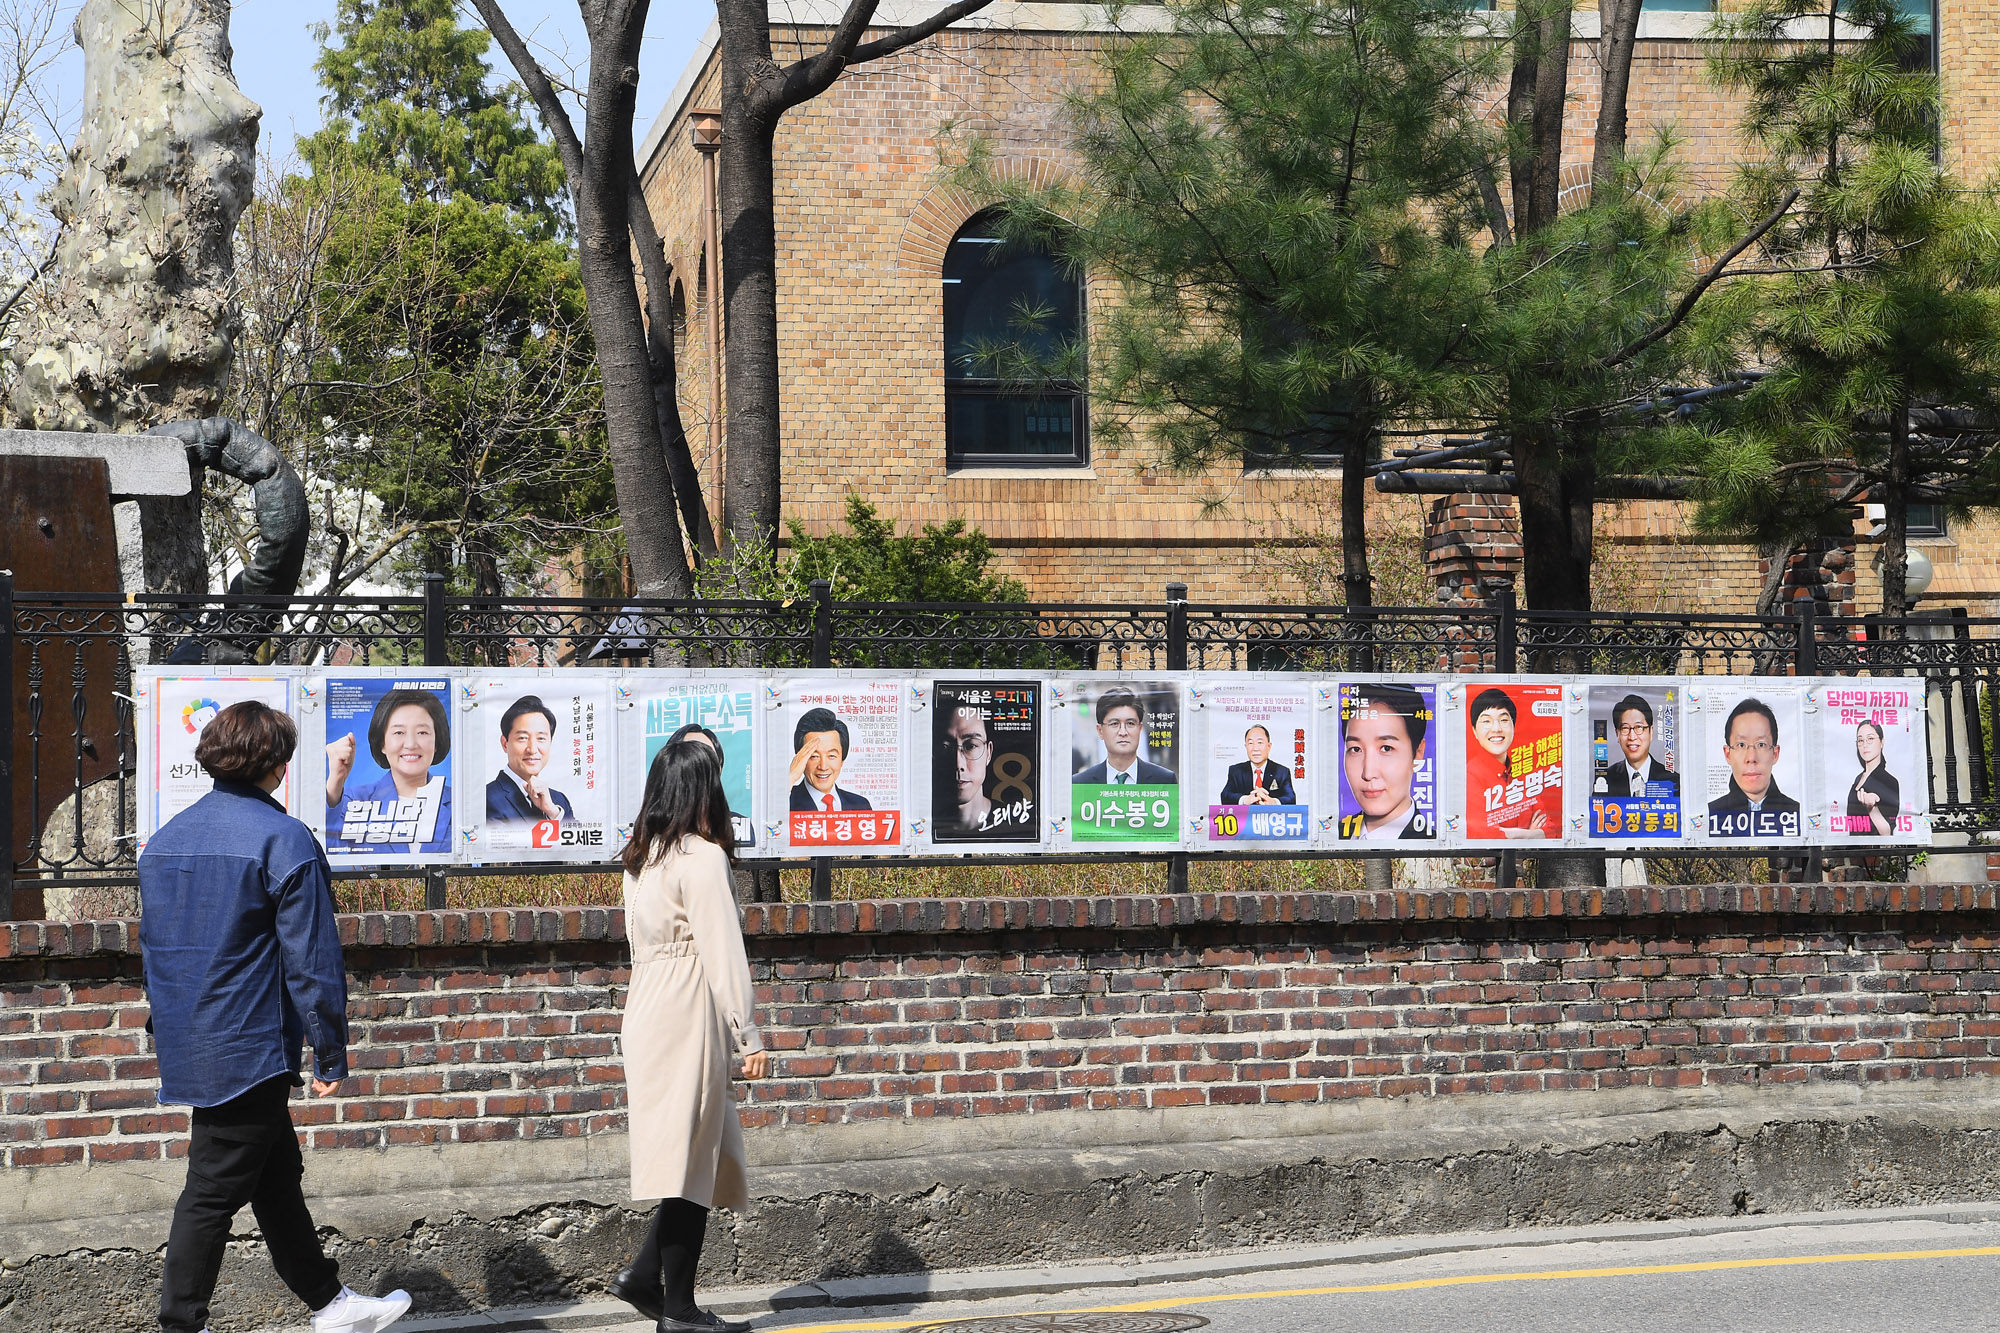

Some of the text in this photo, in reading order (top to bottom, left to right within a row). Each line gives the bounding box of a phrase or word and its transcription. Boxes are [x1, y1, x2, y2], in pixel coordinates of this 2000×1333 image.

[800, 695, 898, 704] 국가에 돈이 없는 것이 아니라
[958, 690, 1033, 704] 서울은 무지개
[1341, 686, 1360, 696] 여자
[1341, 697, 1370, 708] 혼자도
[646, 693, 752, 734] 서울기본소득
[838, 705, 898, 714] 도둑놈이 많습니다
[958, 707, 992, 720] 이기는
[1341, 710, 1433, 720] 살기좋은 서울
[1665, 705, 1673, 728] 서울
[1841, 709, 1866, 725] 있는
[586, 703, 594, 741] 서울부터
[1511, 732, 1561, 763] 강남 해체!
[1665, 728, 1674, 751] 경제
[573, 738, 581, 776] 능숙하게
[1511, 747, 1561, 778] 평등 서울!
[992, 752, 1033, 806] 8
[1484, 765, 1562, 812] 12 송명숙
[1413, 758, 1434, 836] 김진아
[344, 800, 422, 822] 합니다
[416, 776, 446, 843] 1
[978, 798, 1033, 831] 오태양
[1081, 800, 1170, 828] 이수봉 9
[1593, 803, 1622, 833] 13
[1626, 812, 1677, 832] 정동희
[340, 822, 418, 844] 박영선
[540, 822, 554, 846] 2
[809, 819, 876, 840] 허경영
[882, 819, 895, 840] 7
[1214, 814, 1238, 836] 10
[1252, 813, 1303, 836] 배영규
[1341, 815, 1364, 836] 11
[1710, 811, 1798, 837] 14 이도엽
[1898, 816, 1912, 831] 15
[561, 830, 603, 846] 오세훈
